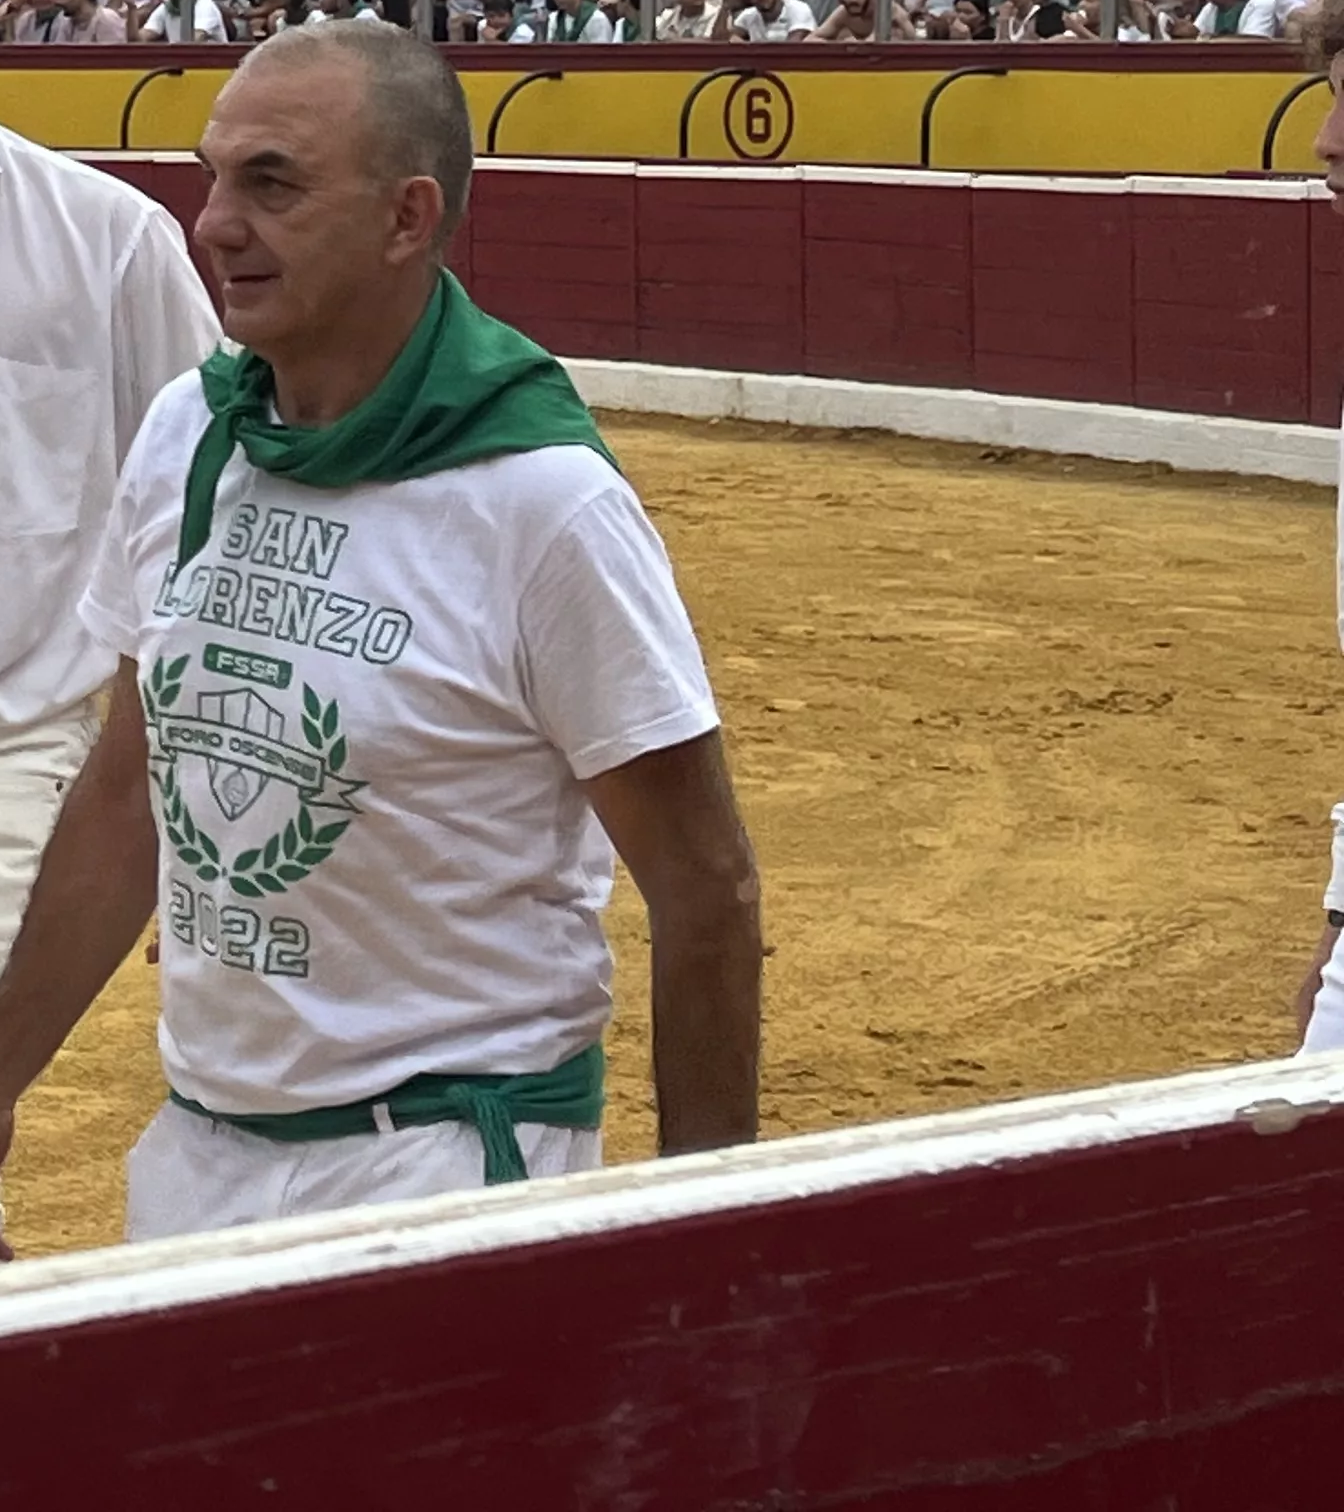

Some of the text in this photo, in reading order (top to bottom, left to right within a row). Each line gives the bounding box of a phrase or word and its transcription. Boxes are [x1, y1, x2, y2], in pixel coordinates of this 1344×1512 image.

[746, 88, 772, 144] 6
[221, 503, 349, 580] SAN
[153, 560, 413, 666] LORENZO
[166, 725, 223, 748] FORO
[169, 878, 310, 978] 2022
